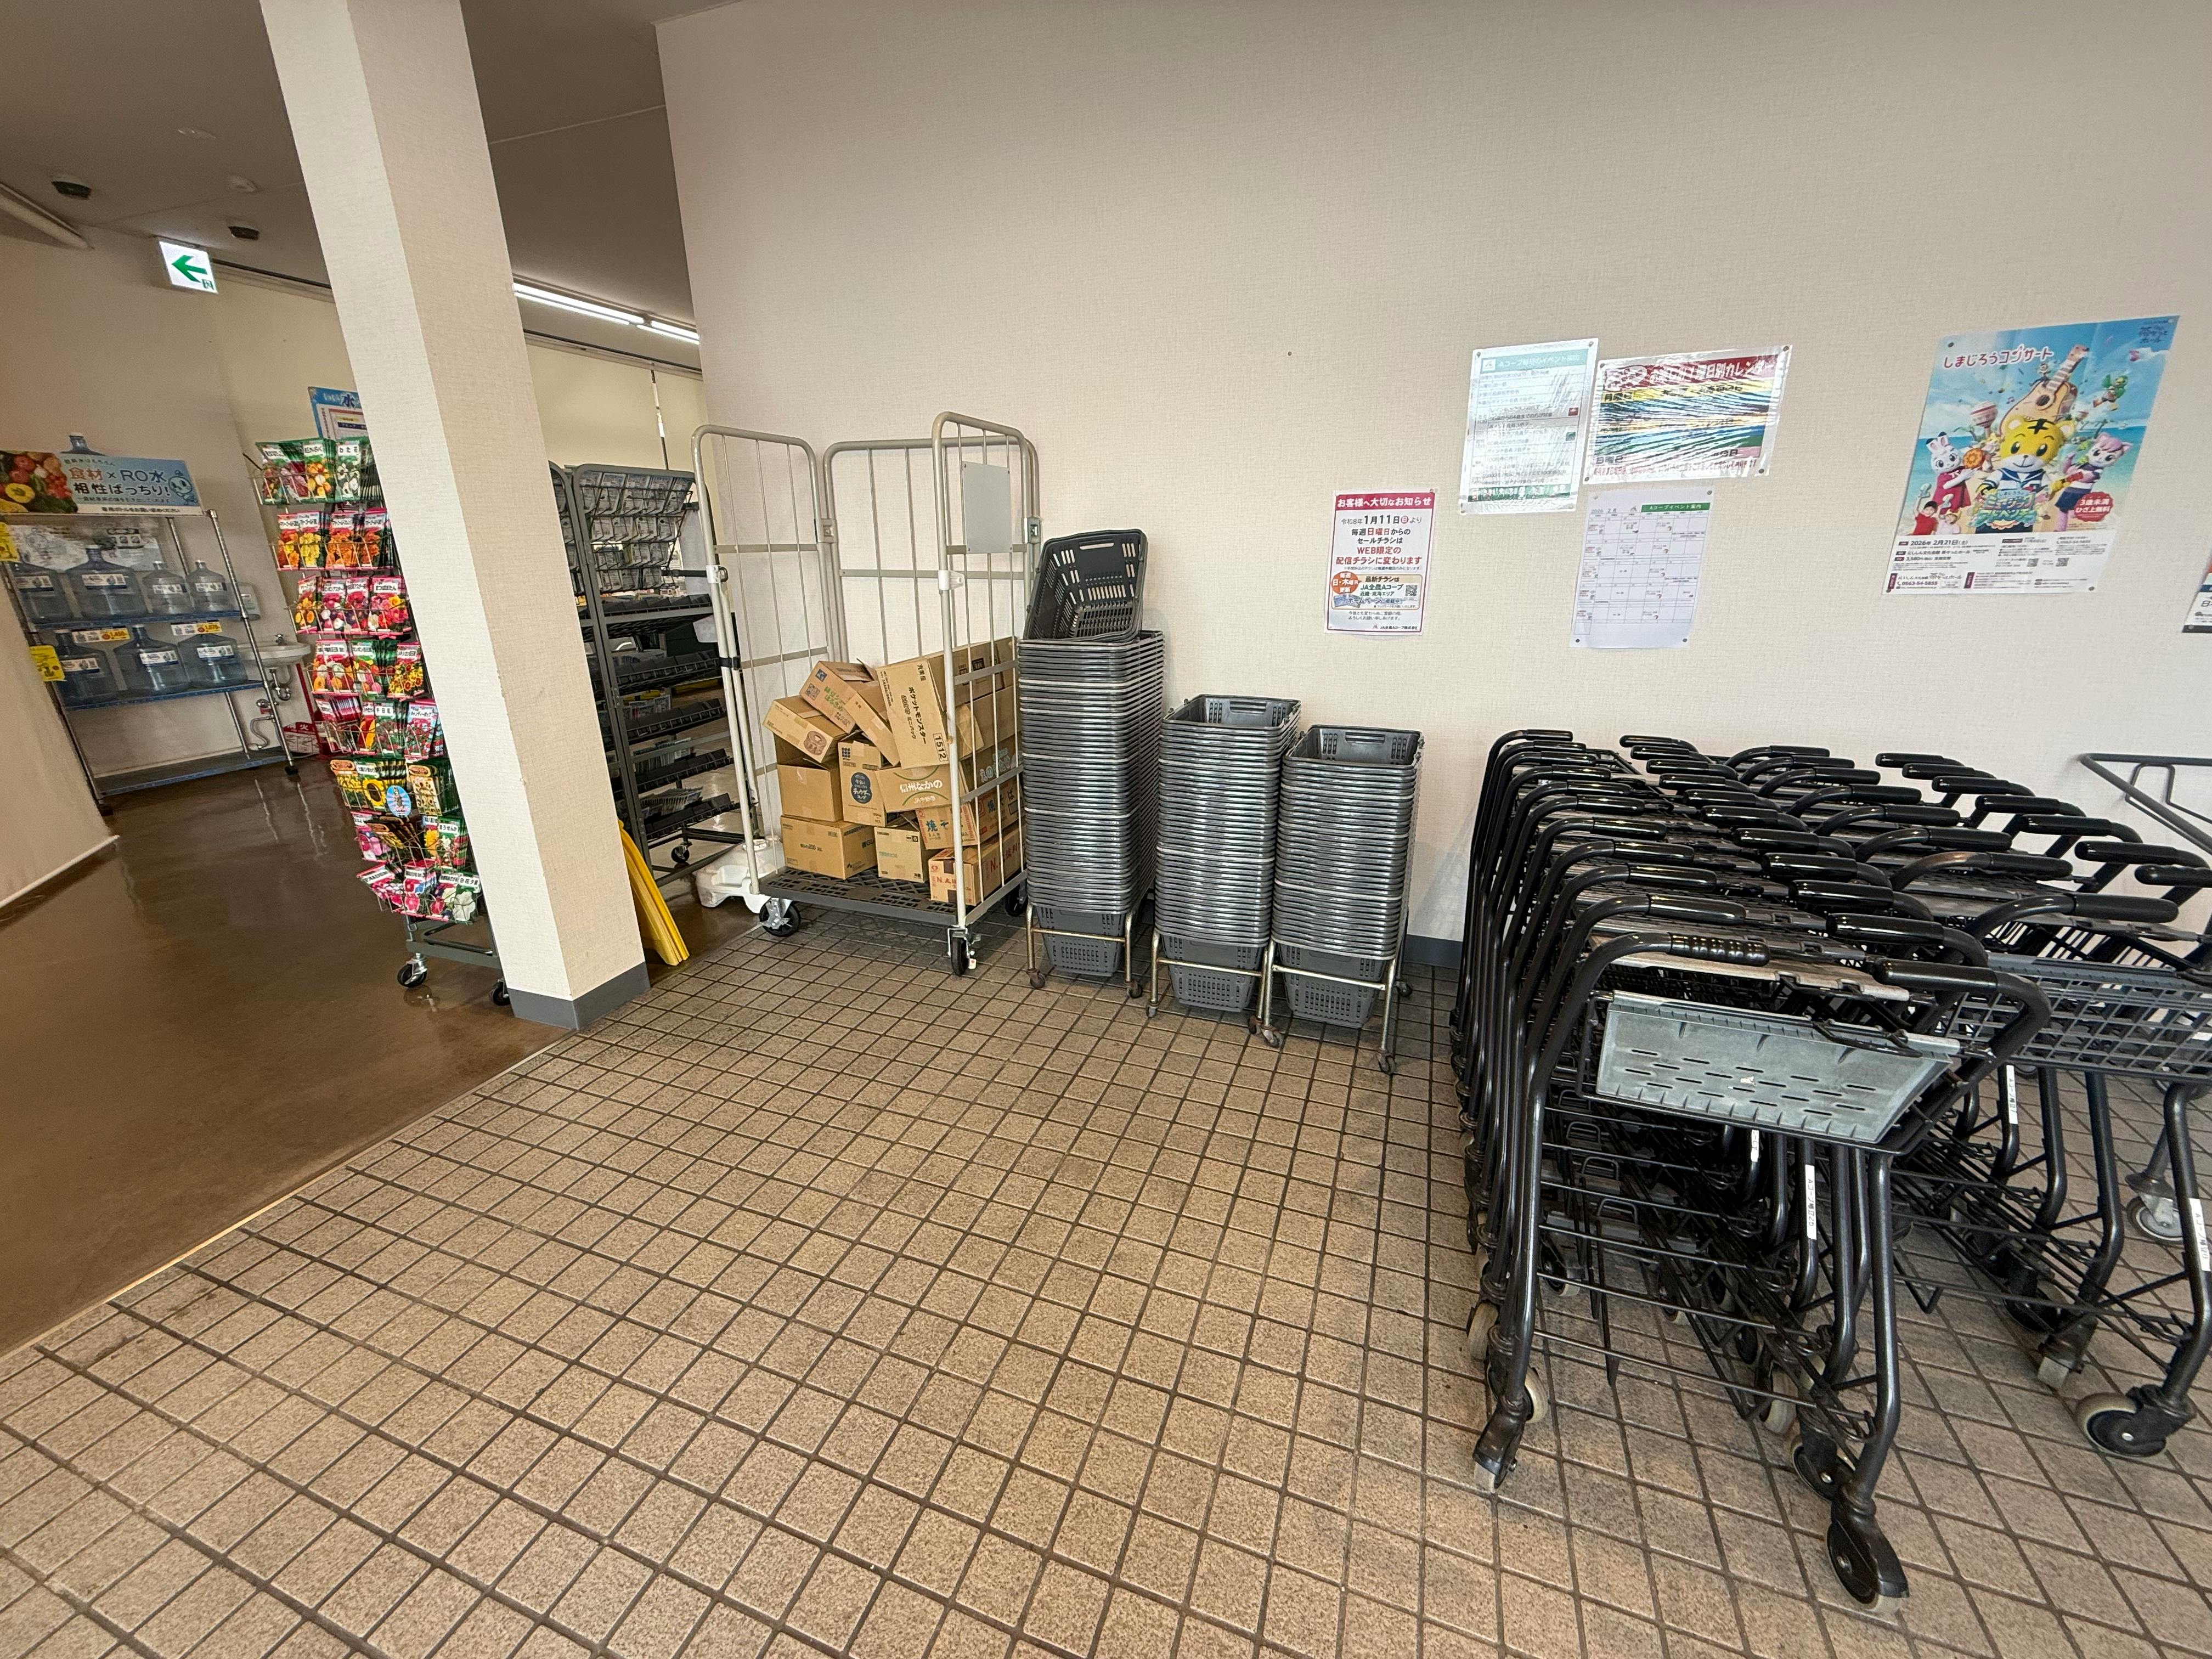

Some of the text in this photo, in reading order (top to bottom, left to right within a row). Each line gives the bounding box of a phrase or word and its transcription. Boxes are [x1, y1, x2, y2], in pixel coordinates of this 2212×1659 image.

[1944, 346, 2052, 368] しまじろうコンサート
[1337, 496, 1432, 508] お客様へ大切なお知らせ
[1351, 528, 1411, 536] 毎週日曜日からの
[1336, 556, 1423, 565] 配信チラシに変わります
[917, 664, 927, 681] 丸美屋
[909, 686, 927, 744] ポケットモンスター
[907, 716, 917, 740] ミニパック
[935, 736, 947, 759] 1512
[900, 780, 943, 793] 信州なかの
